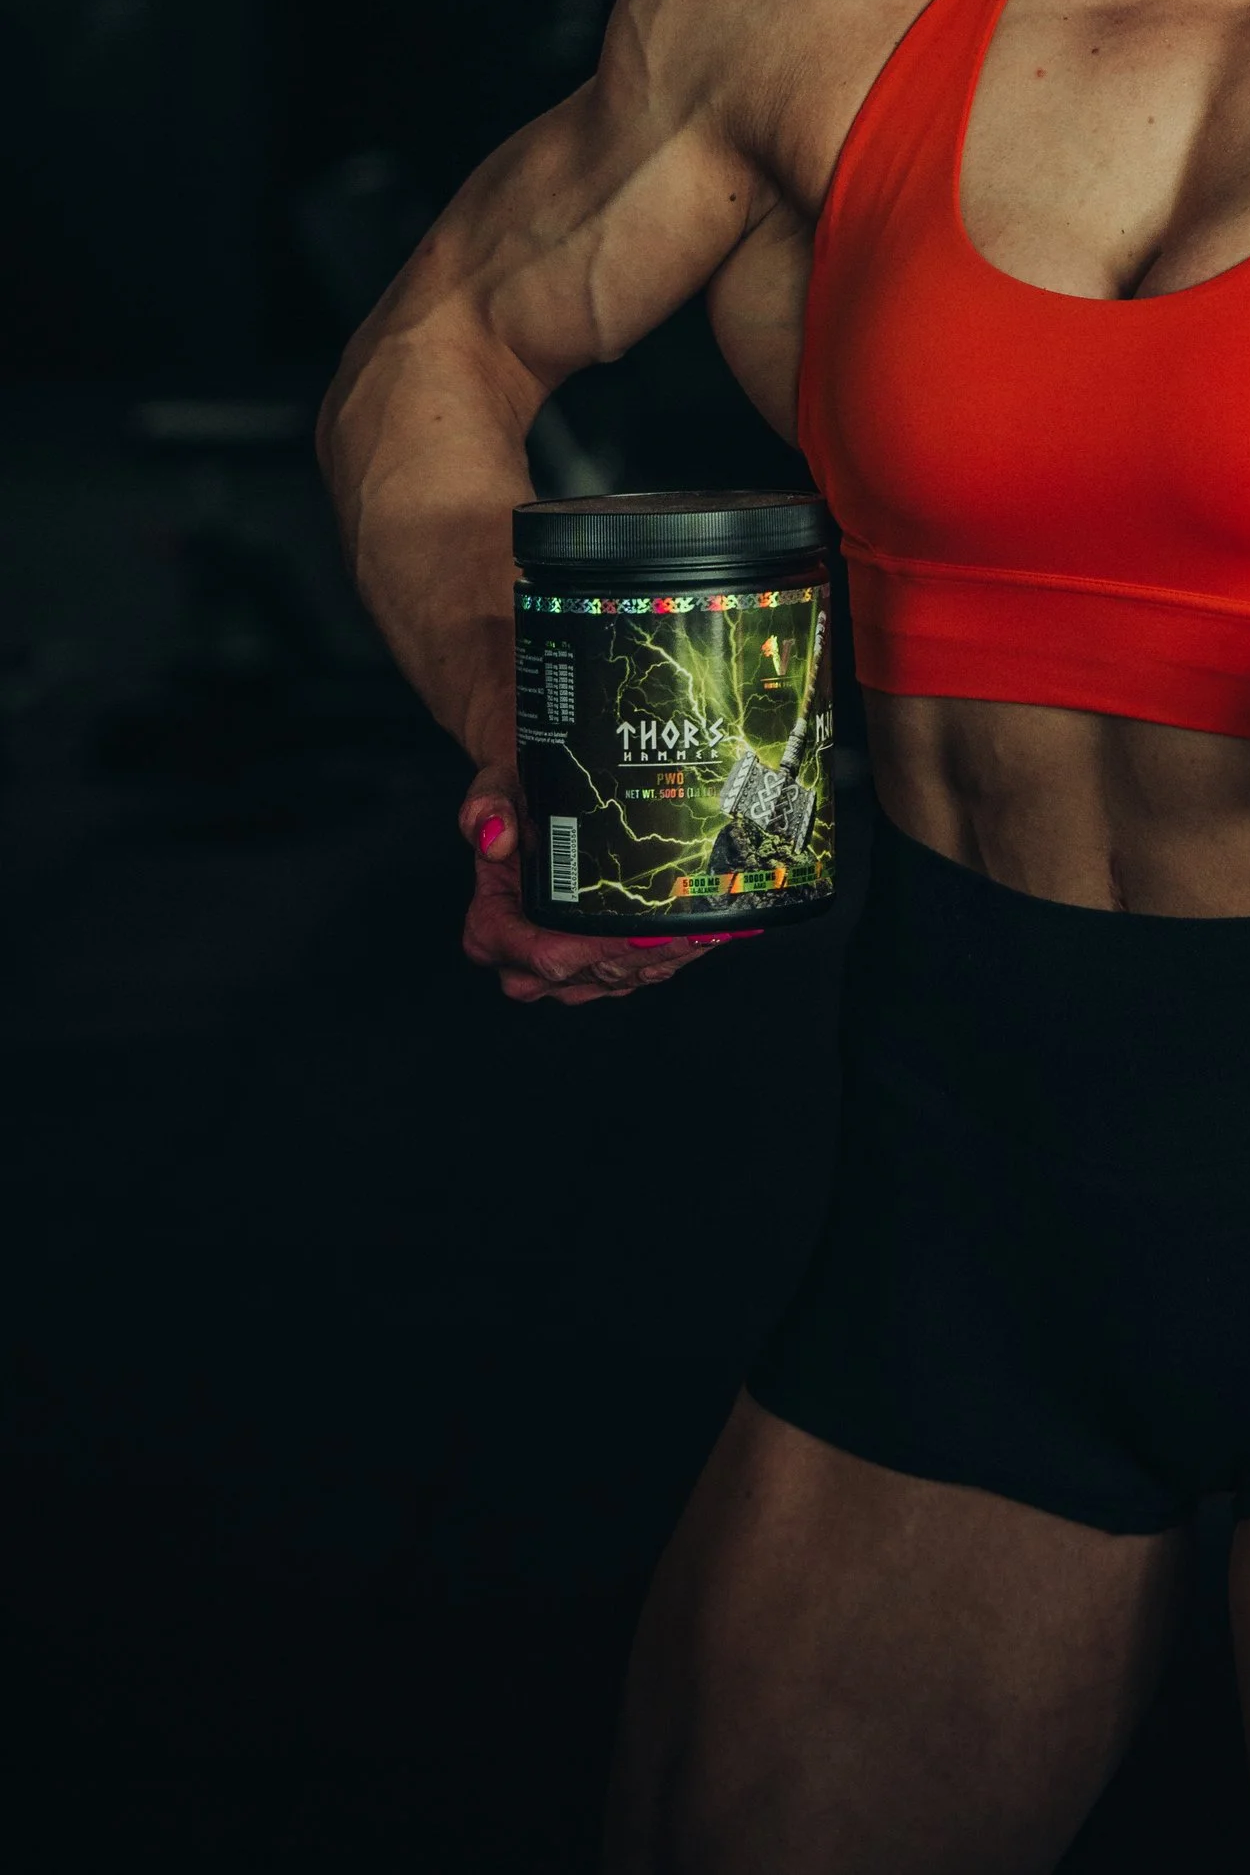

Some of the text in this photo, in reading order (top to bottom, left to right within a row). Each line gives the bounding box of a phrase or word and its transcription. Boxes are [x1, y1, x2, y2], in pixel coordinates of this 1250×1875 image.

[616, 718, 724, 750] THORS
[623, 749, 719, 761] HAMMER
[625, 789, 639, 799] NET
[642, 789, 657, 799] WT.
[660, 788, 676, 798] 500
[677, 788, 684, 798] G
[683, 877, 720, 887] 5000 MG
[744, 873, 763, 883] 3000
